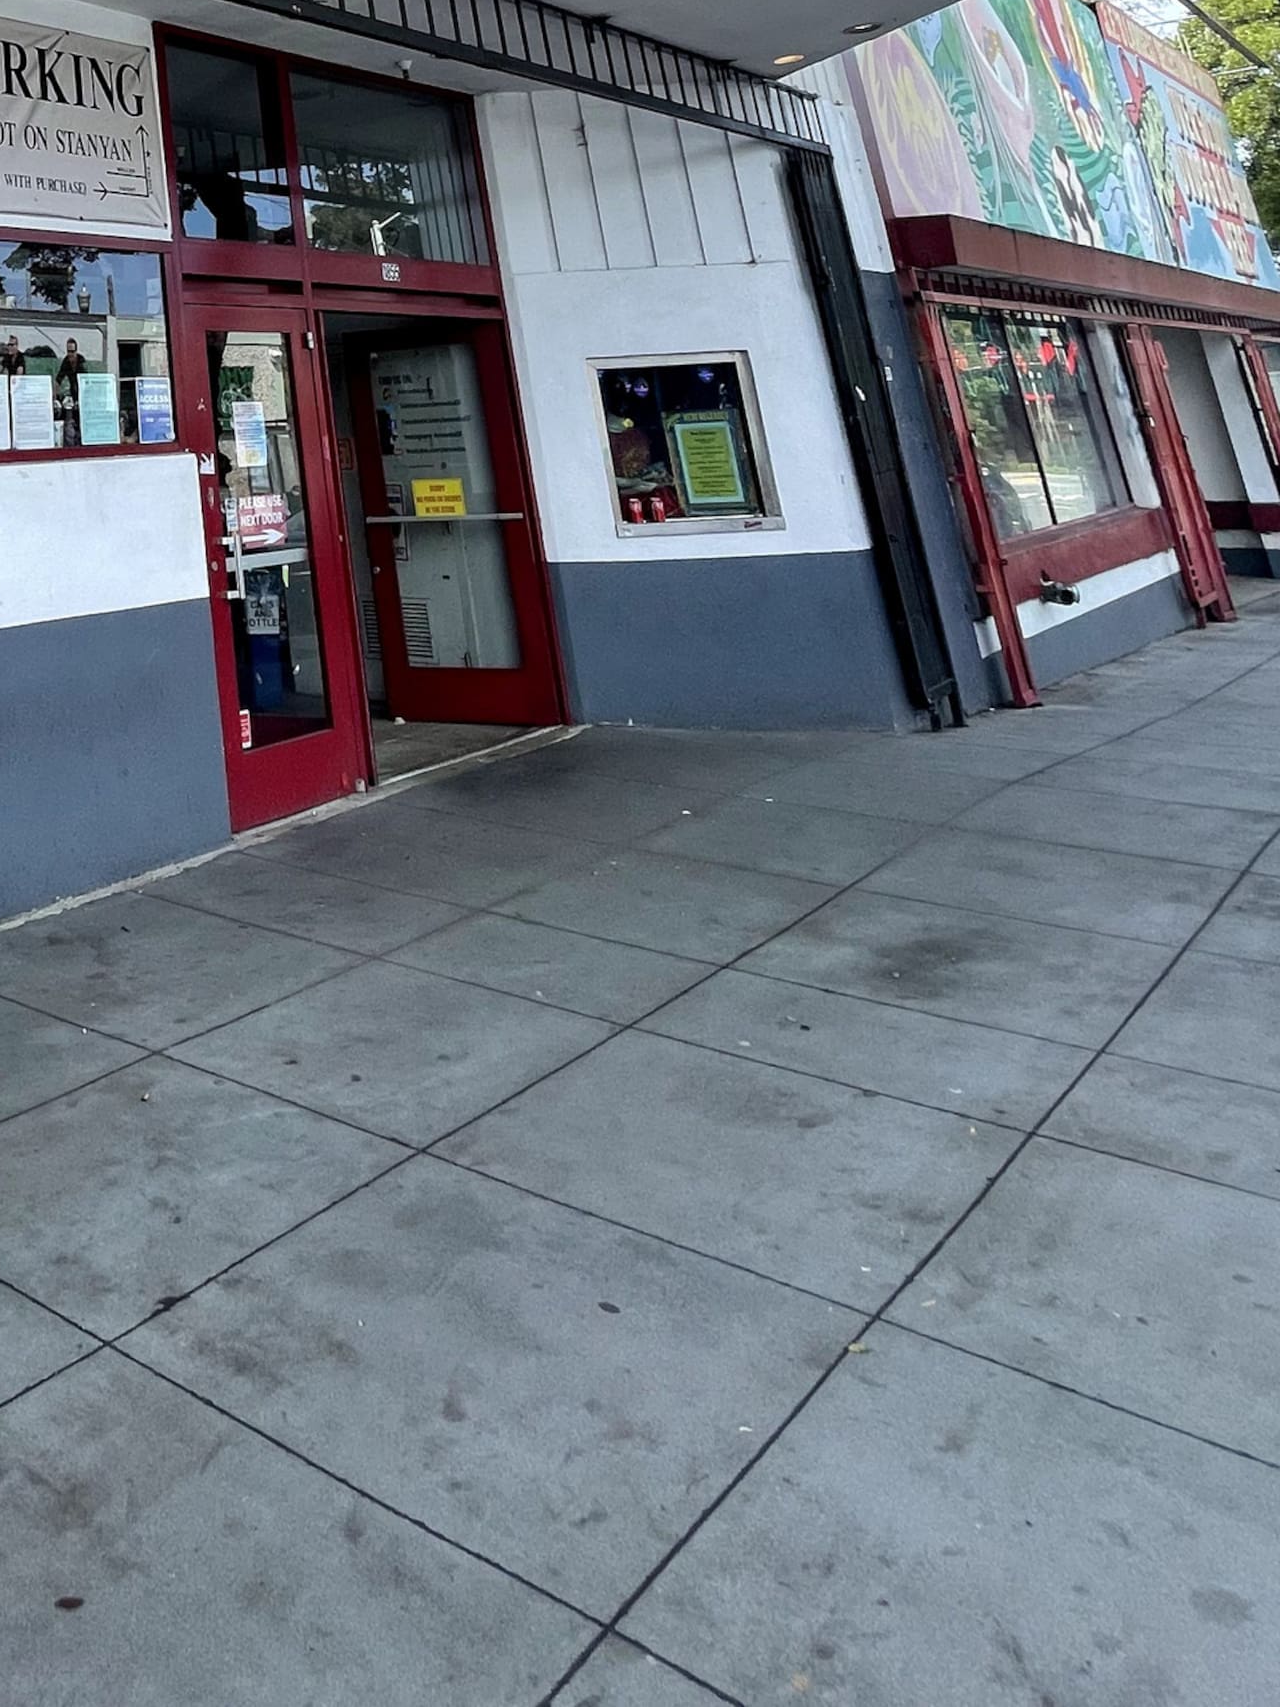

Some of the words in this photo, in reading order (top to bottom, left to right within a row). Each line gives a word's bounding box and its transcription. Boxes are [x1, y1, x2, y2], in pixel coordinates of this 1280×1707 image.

[24, 125, 48, 151] ON
[56, 130, 133, 163] STANYAN
[4, 173, 32, 190] WITH
[36, 177, 88, 196] PURCHASE)
[239, 495, 266, 508] PLEASE
[267, 494, 282, 506] USE
[240, 514, 261, 527] NEXT
[261, 511, 284, 525] DOOR
